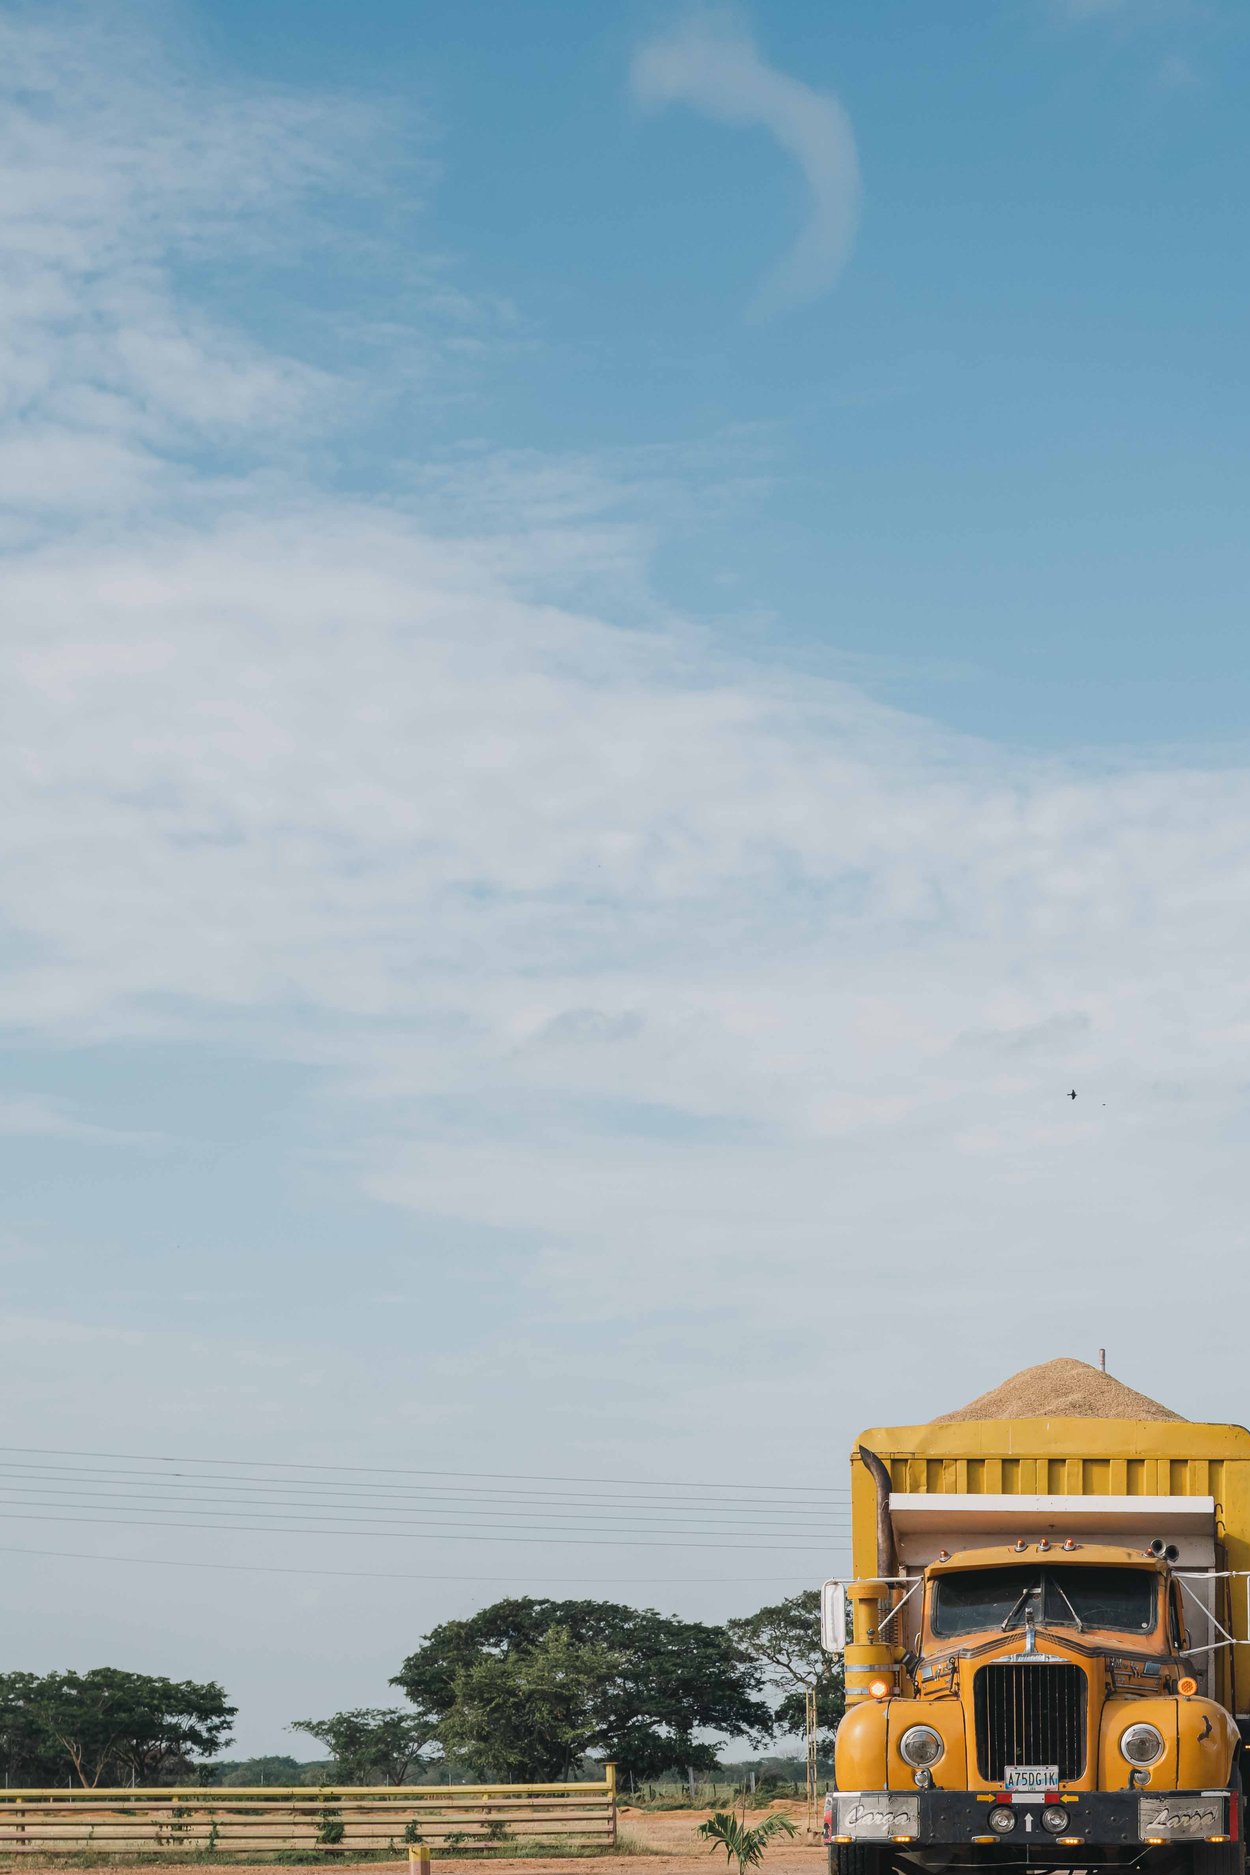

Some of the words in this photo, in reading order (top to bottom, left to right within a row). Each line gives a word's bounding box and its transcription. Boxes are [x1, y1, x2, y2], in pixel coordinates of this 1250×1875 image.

[1008, 1772, 1056, 1786] A75DG1K
[844, 1802, 911, 1831] Carga
[1145, 1807, 1216, 1832] Larga
